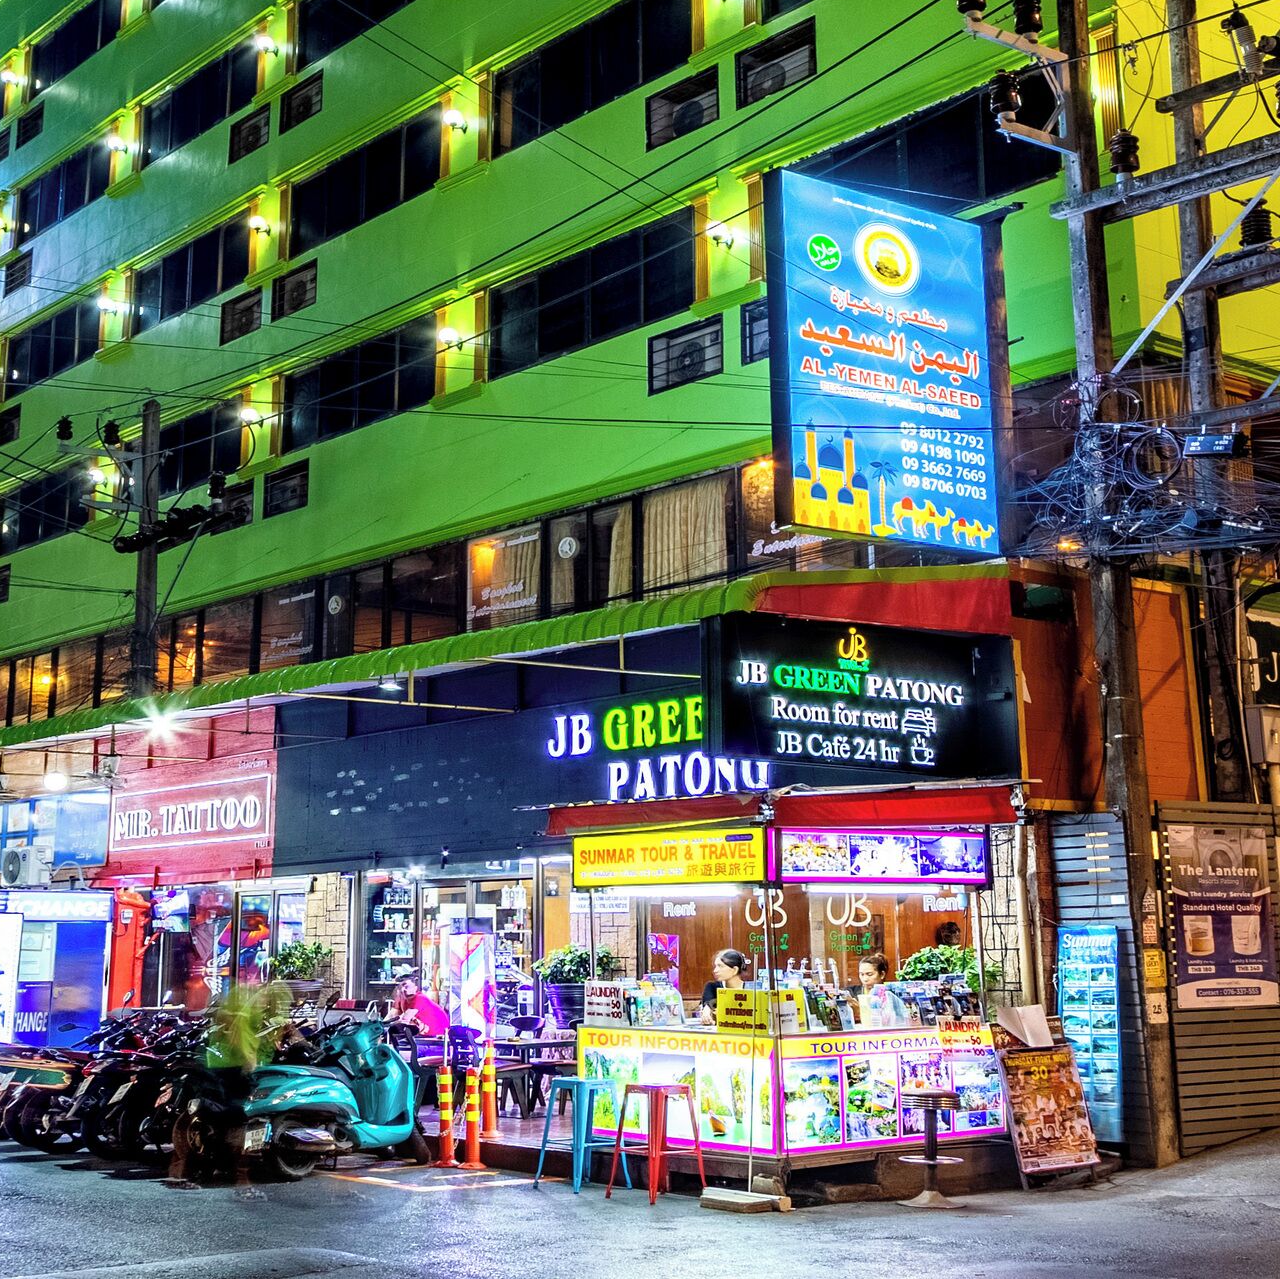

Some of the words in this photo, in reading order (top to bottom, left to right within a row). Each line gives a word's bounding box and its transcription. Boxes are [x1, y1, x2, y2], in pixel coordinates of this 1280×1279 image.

[800, 318, 906, 361] السعيد
[910, 340, 980, 385] اليمن
[900, 379, 982, 409] AL-SAEED
[953, 431, 985, 450] 2792
[901, 438, 918, 453] 09
[919, 443, 952, 460] 4198
[954, 449, 985, 466] 1090
[901, 455, 919, 470] 09
[921, 459, 953, 477] 3662
[955, 466, 986, 483] 7669
[902, 473, 920, 488] 09
[921, 476, 954, 494] 8706
[955, 483, 987, 500] 0703
[736, 660, 768, 685] JB
[773, 664, 861, 696] GREEN
[866, 674, 964, 706] PATONG
[771, 696, 831, 724] Room
[832, 701, 861, 727] for
[863, 709, 899, 730] rent
[547, 713, 593, 758] JB
[777, 731, 803, 755] JB
[806, 732, 851, 761] Café
[854, 739, 877, 761] 24
[879, 740, 901, 763] hr
[579, 848, 635, 866] SUNMAR
[641, 845, 678, 862] TOUR
[684, 846, 694, 861] &
[699, 841, 757, 860] TRAVEL
[1179, 864, 1204, 876] The
[1208, 865, 1258, 877] Lantern
[663, 901, 697, 918] Rent
[1236, 904, 1262, 913] Quality
[829, 931, 858, 942] Green
[586, 986, 620, 999] LAUNDRY
[611, 1000, 621, 1010] 50
[610, 1011, 623, 1019] 100
[939, 1021, 981, 1033] LAUNDRY
[587, 1032, 632, 1048] TOUR
[640, 1036, 766, 1058] INFORMATION
[810, 1039, 857, 1054] TOUR
[970, 1035, 981, 1045] 50
[973, 1047, 985, 1056] 100
[1031, 1065, 1049, 1080] 30
